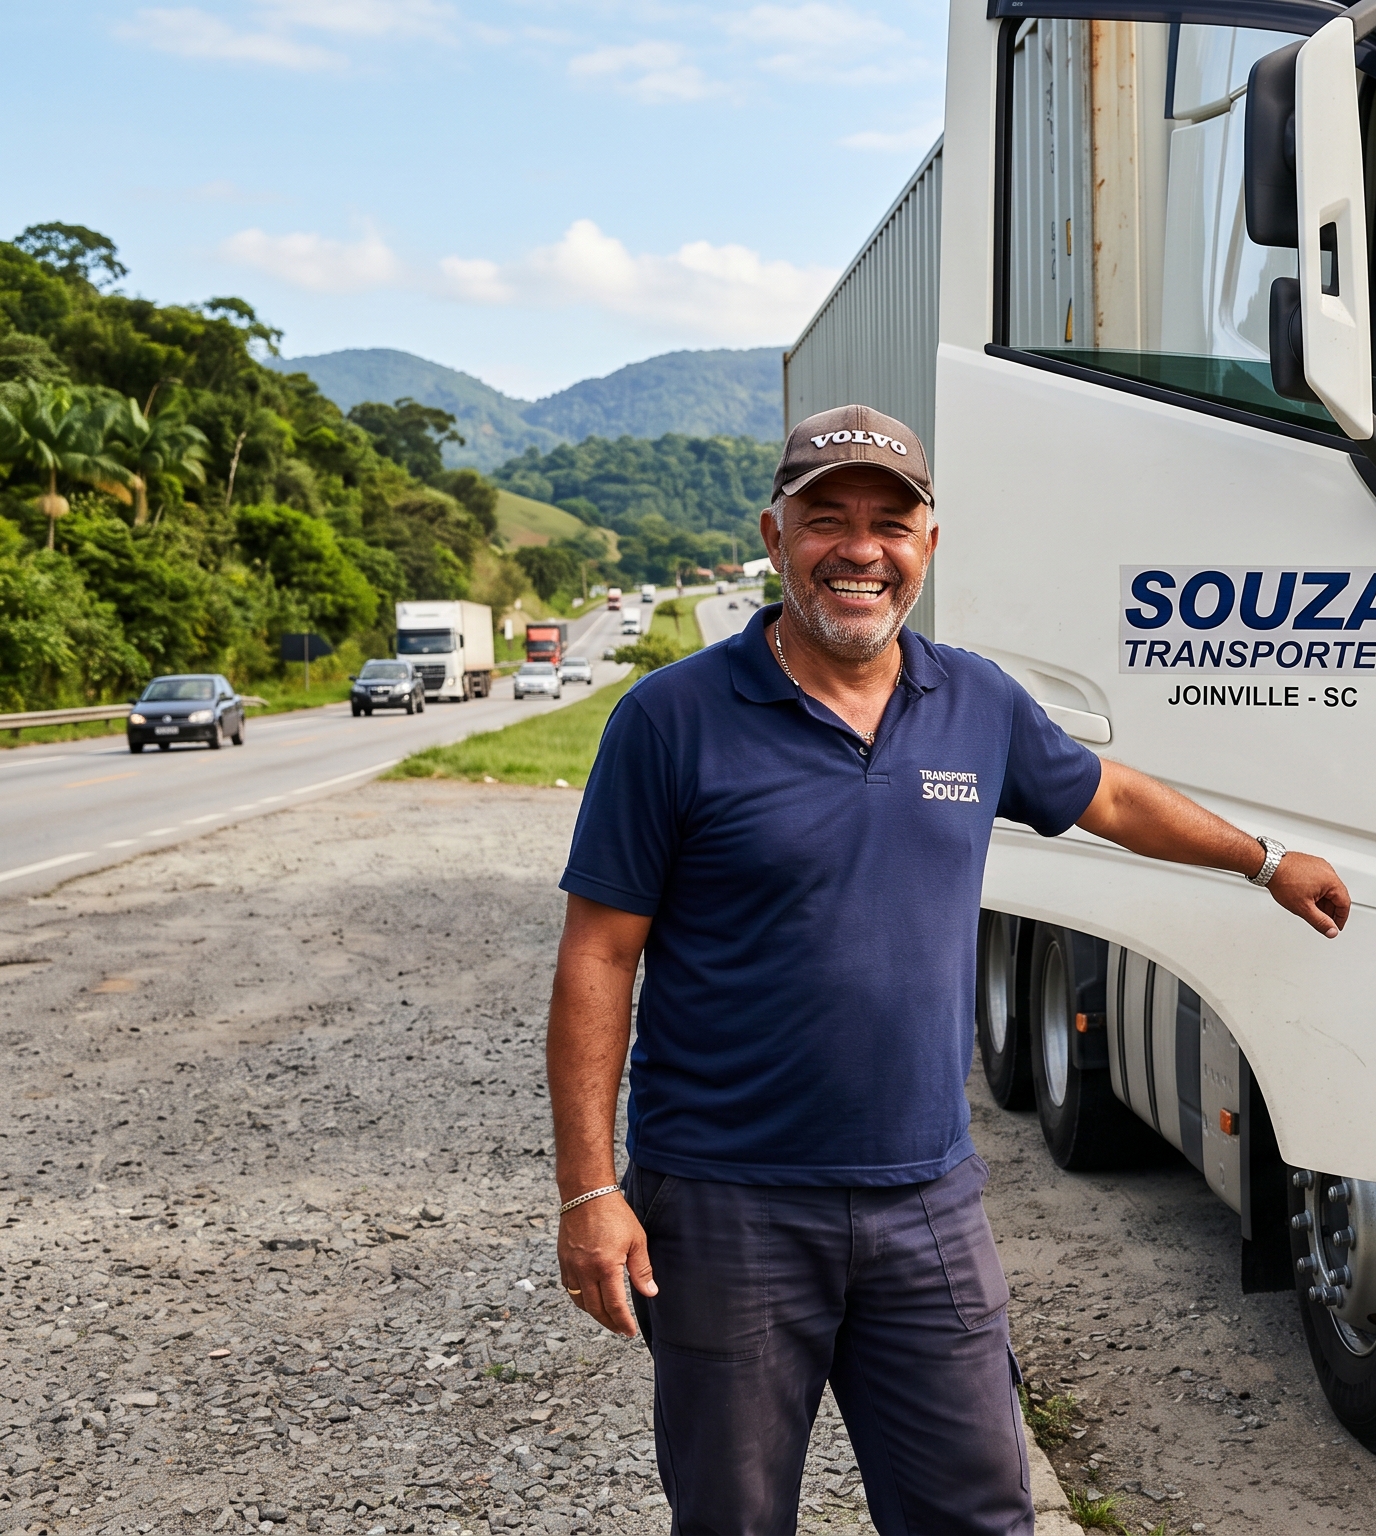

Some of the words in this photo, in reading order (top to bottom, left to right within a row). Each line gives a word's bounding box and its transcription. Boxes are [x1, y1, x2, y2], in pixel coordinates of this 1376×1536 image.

[810, 429, 908, 456] VOLVO
[1168, 685, 1299, 706] JOINVILLE
[1323, 687, 1358, 707] SC
[919, 769, 977, 783] TRANSPORTE
[922, 782, 979, 803] SOUZA
